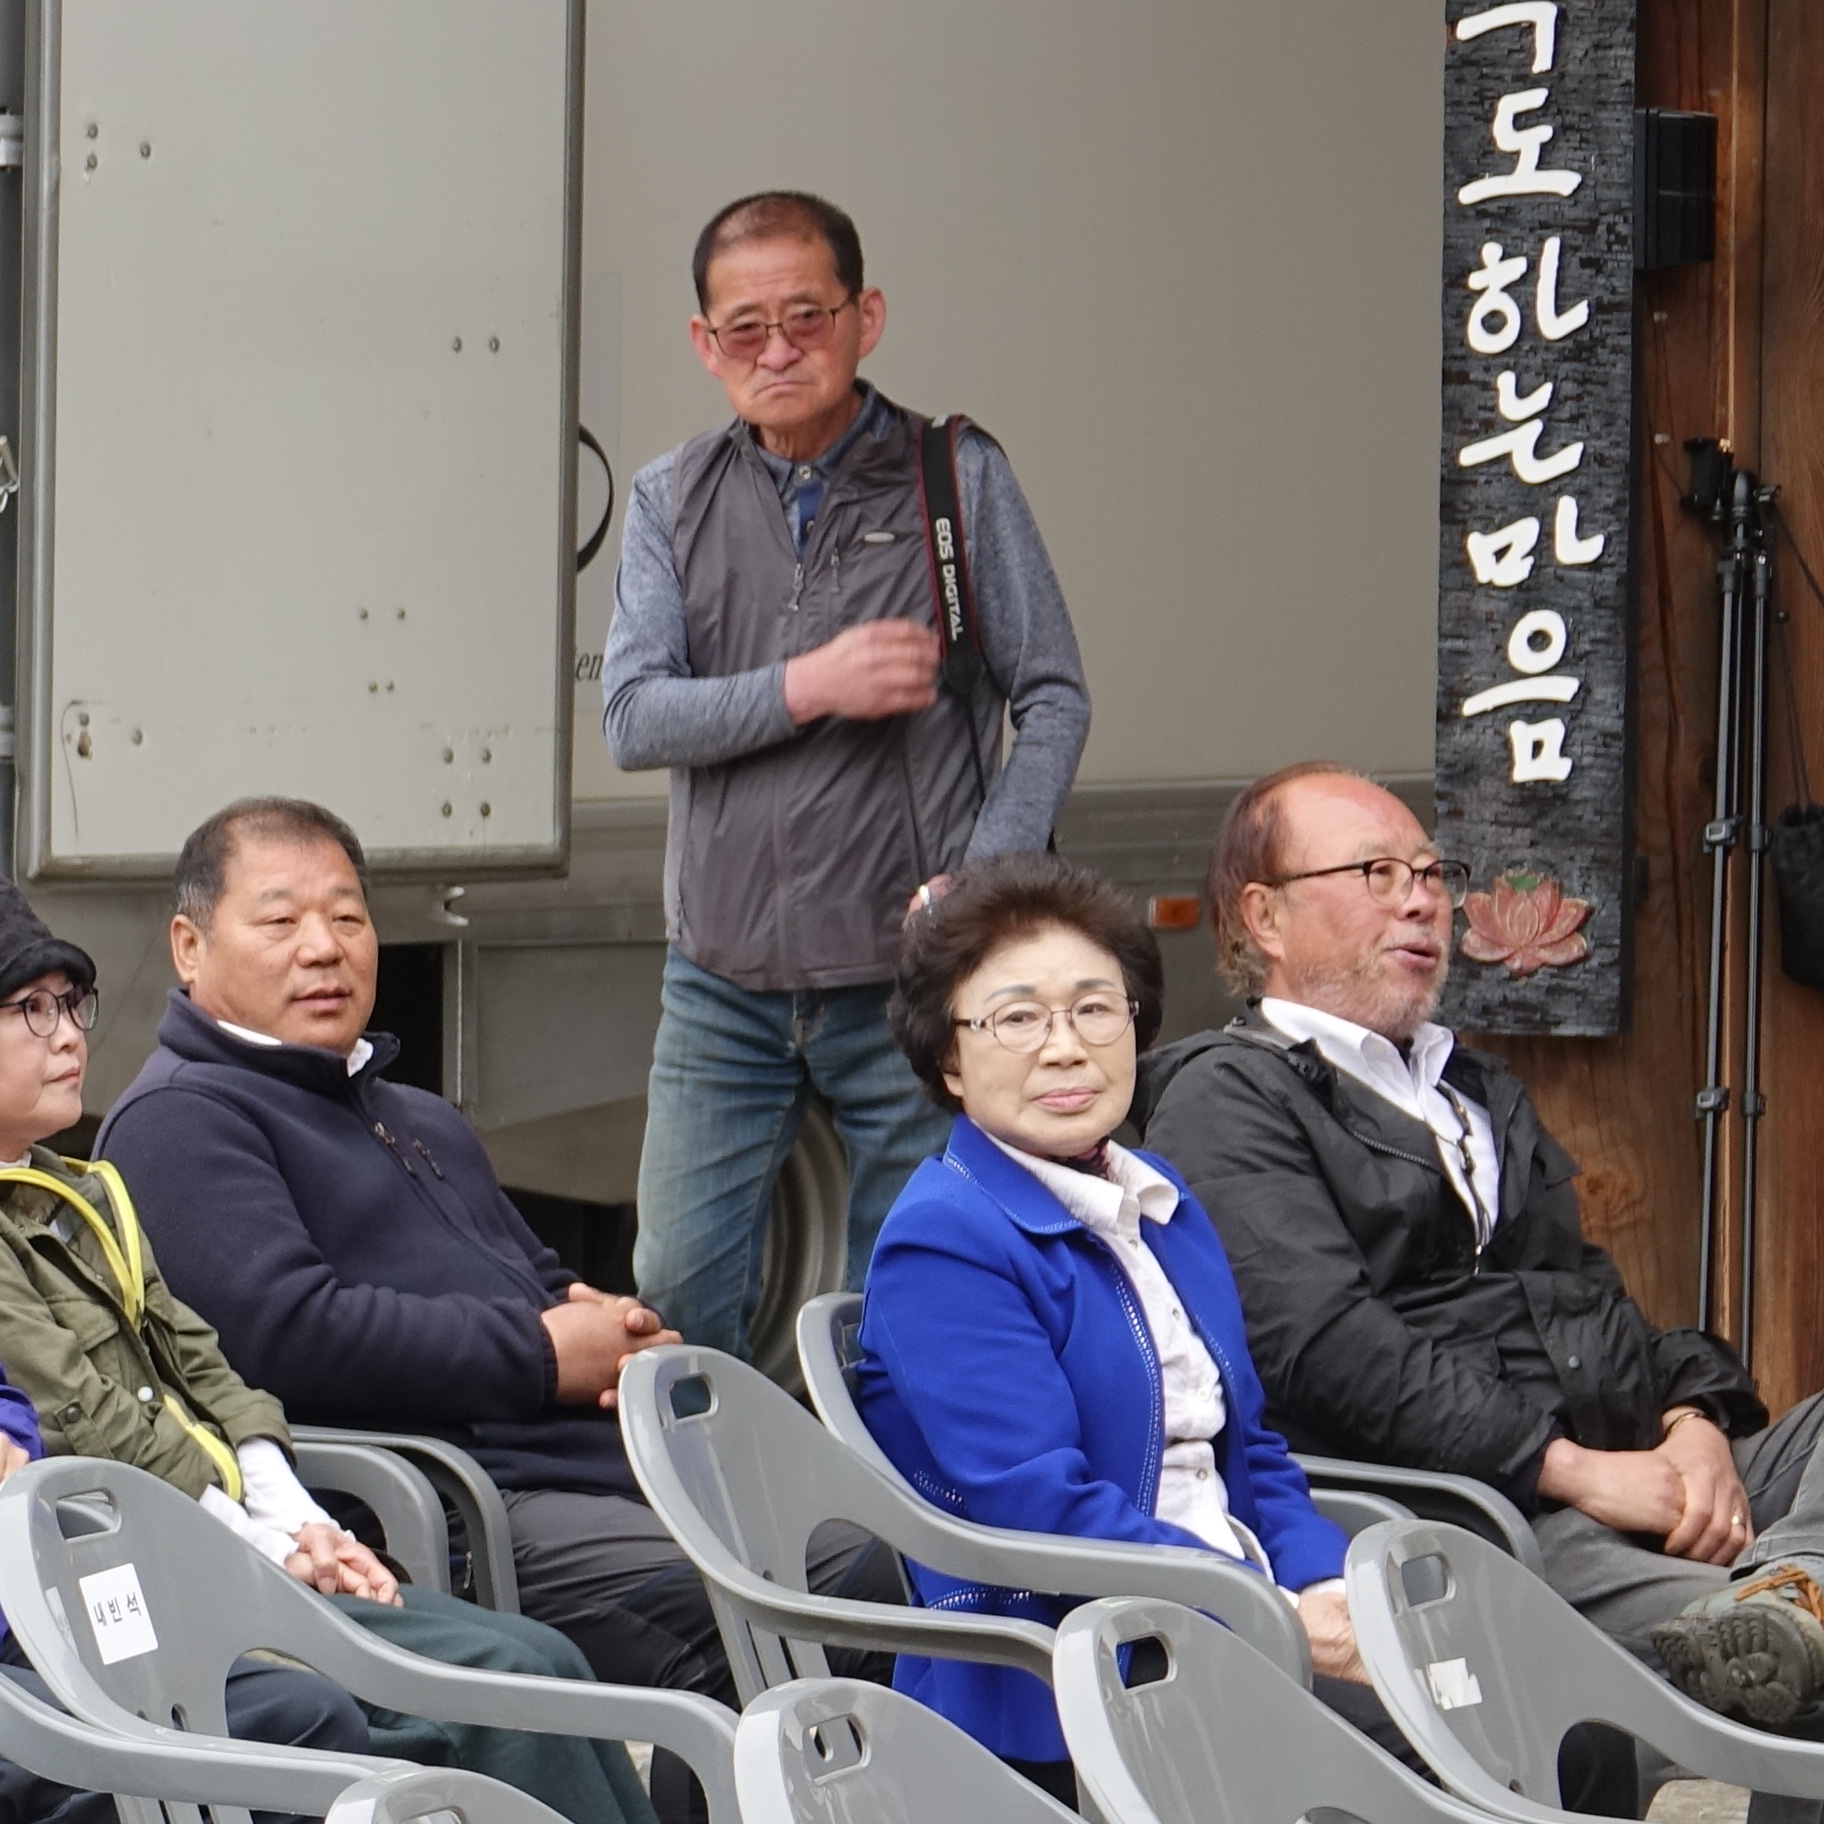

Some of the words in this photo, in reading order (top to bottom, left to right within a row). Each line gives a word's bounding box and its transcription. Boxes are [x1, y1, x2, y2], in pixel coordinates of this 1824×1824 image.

[935, 517, 954, 560] EOS
[942, 563, 964, 642] DIGITAL
[1462, 495, 1605, 782] 마음
